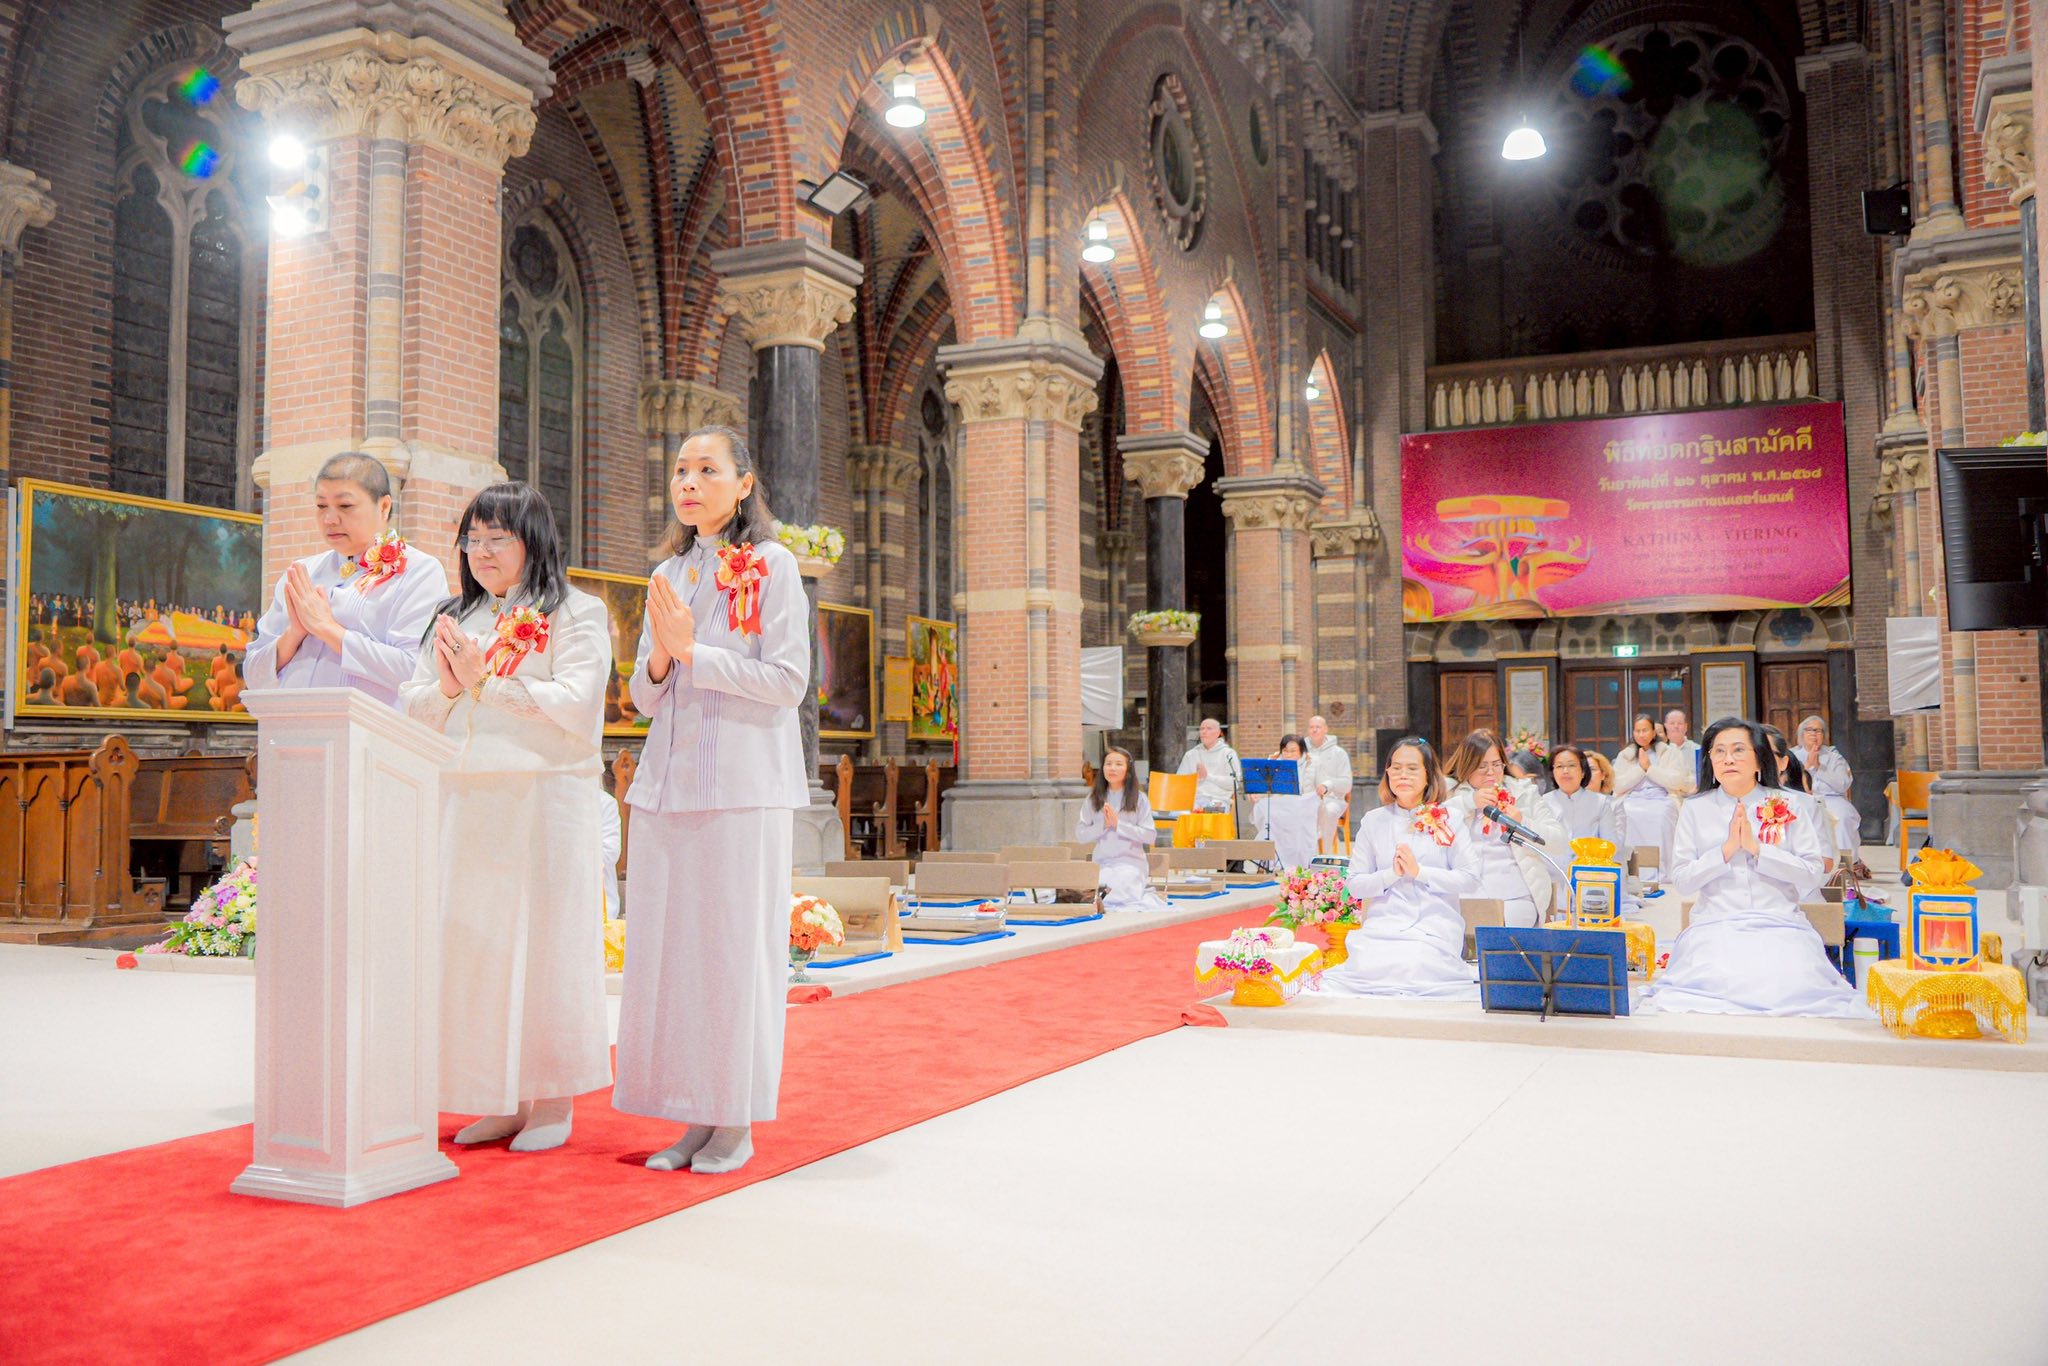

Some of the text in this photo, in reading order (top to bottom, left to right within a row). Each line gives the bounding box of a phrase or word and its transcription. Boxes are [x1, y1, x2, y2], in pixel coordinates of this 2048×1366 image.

[1603, 426, 1813, 464] พิธีทอดกฐินสามัคคี
[1700, 472, 1747, 489] ตุลาคม
[1725, 527, 1799, 541] VIERING
